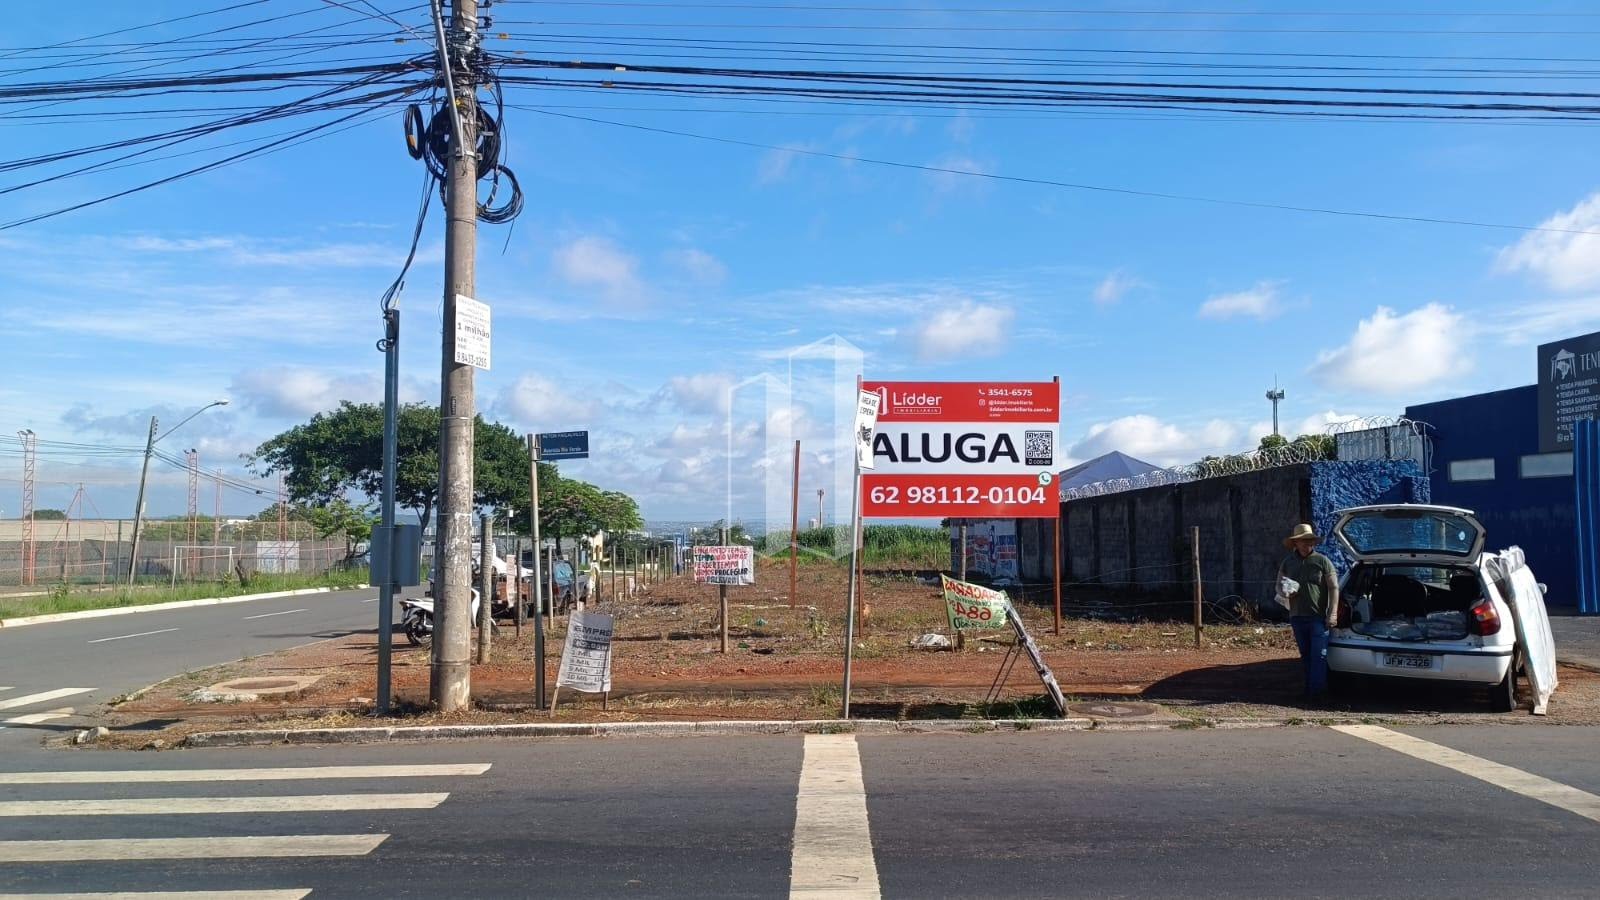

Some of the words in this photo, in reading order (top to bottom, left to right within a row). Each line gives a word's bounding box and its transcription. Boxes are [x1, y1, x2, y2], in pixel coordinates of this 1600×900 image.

[893, 391, 943, 406] Lídder
[988, 388, 1033, 397] 3541-6575
[873, 432, 1020, 463] ALUGA
[870, 486, 900, 504] 62
[906, 486, 1046, 504] 98112-0104
